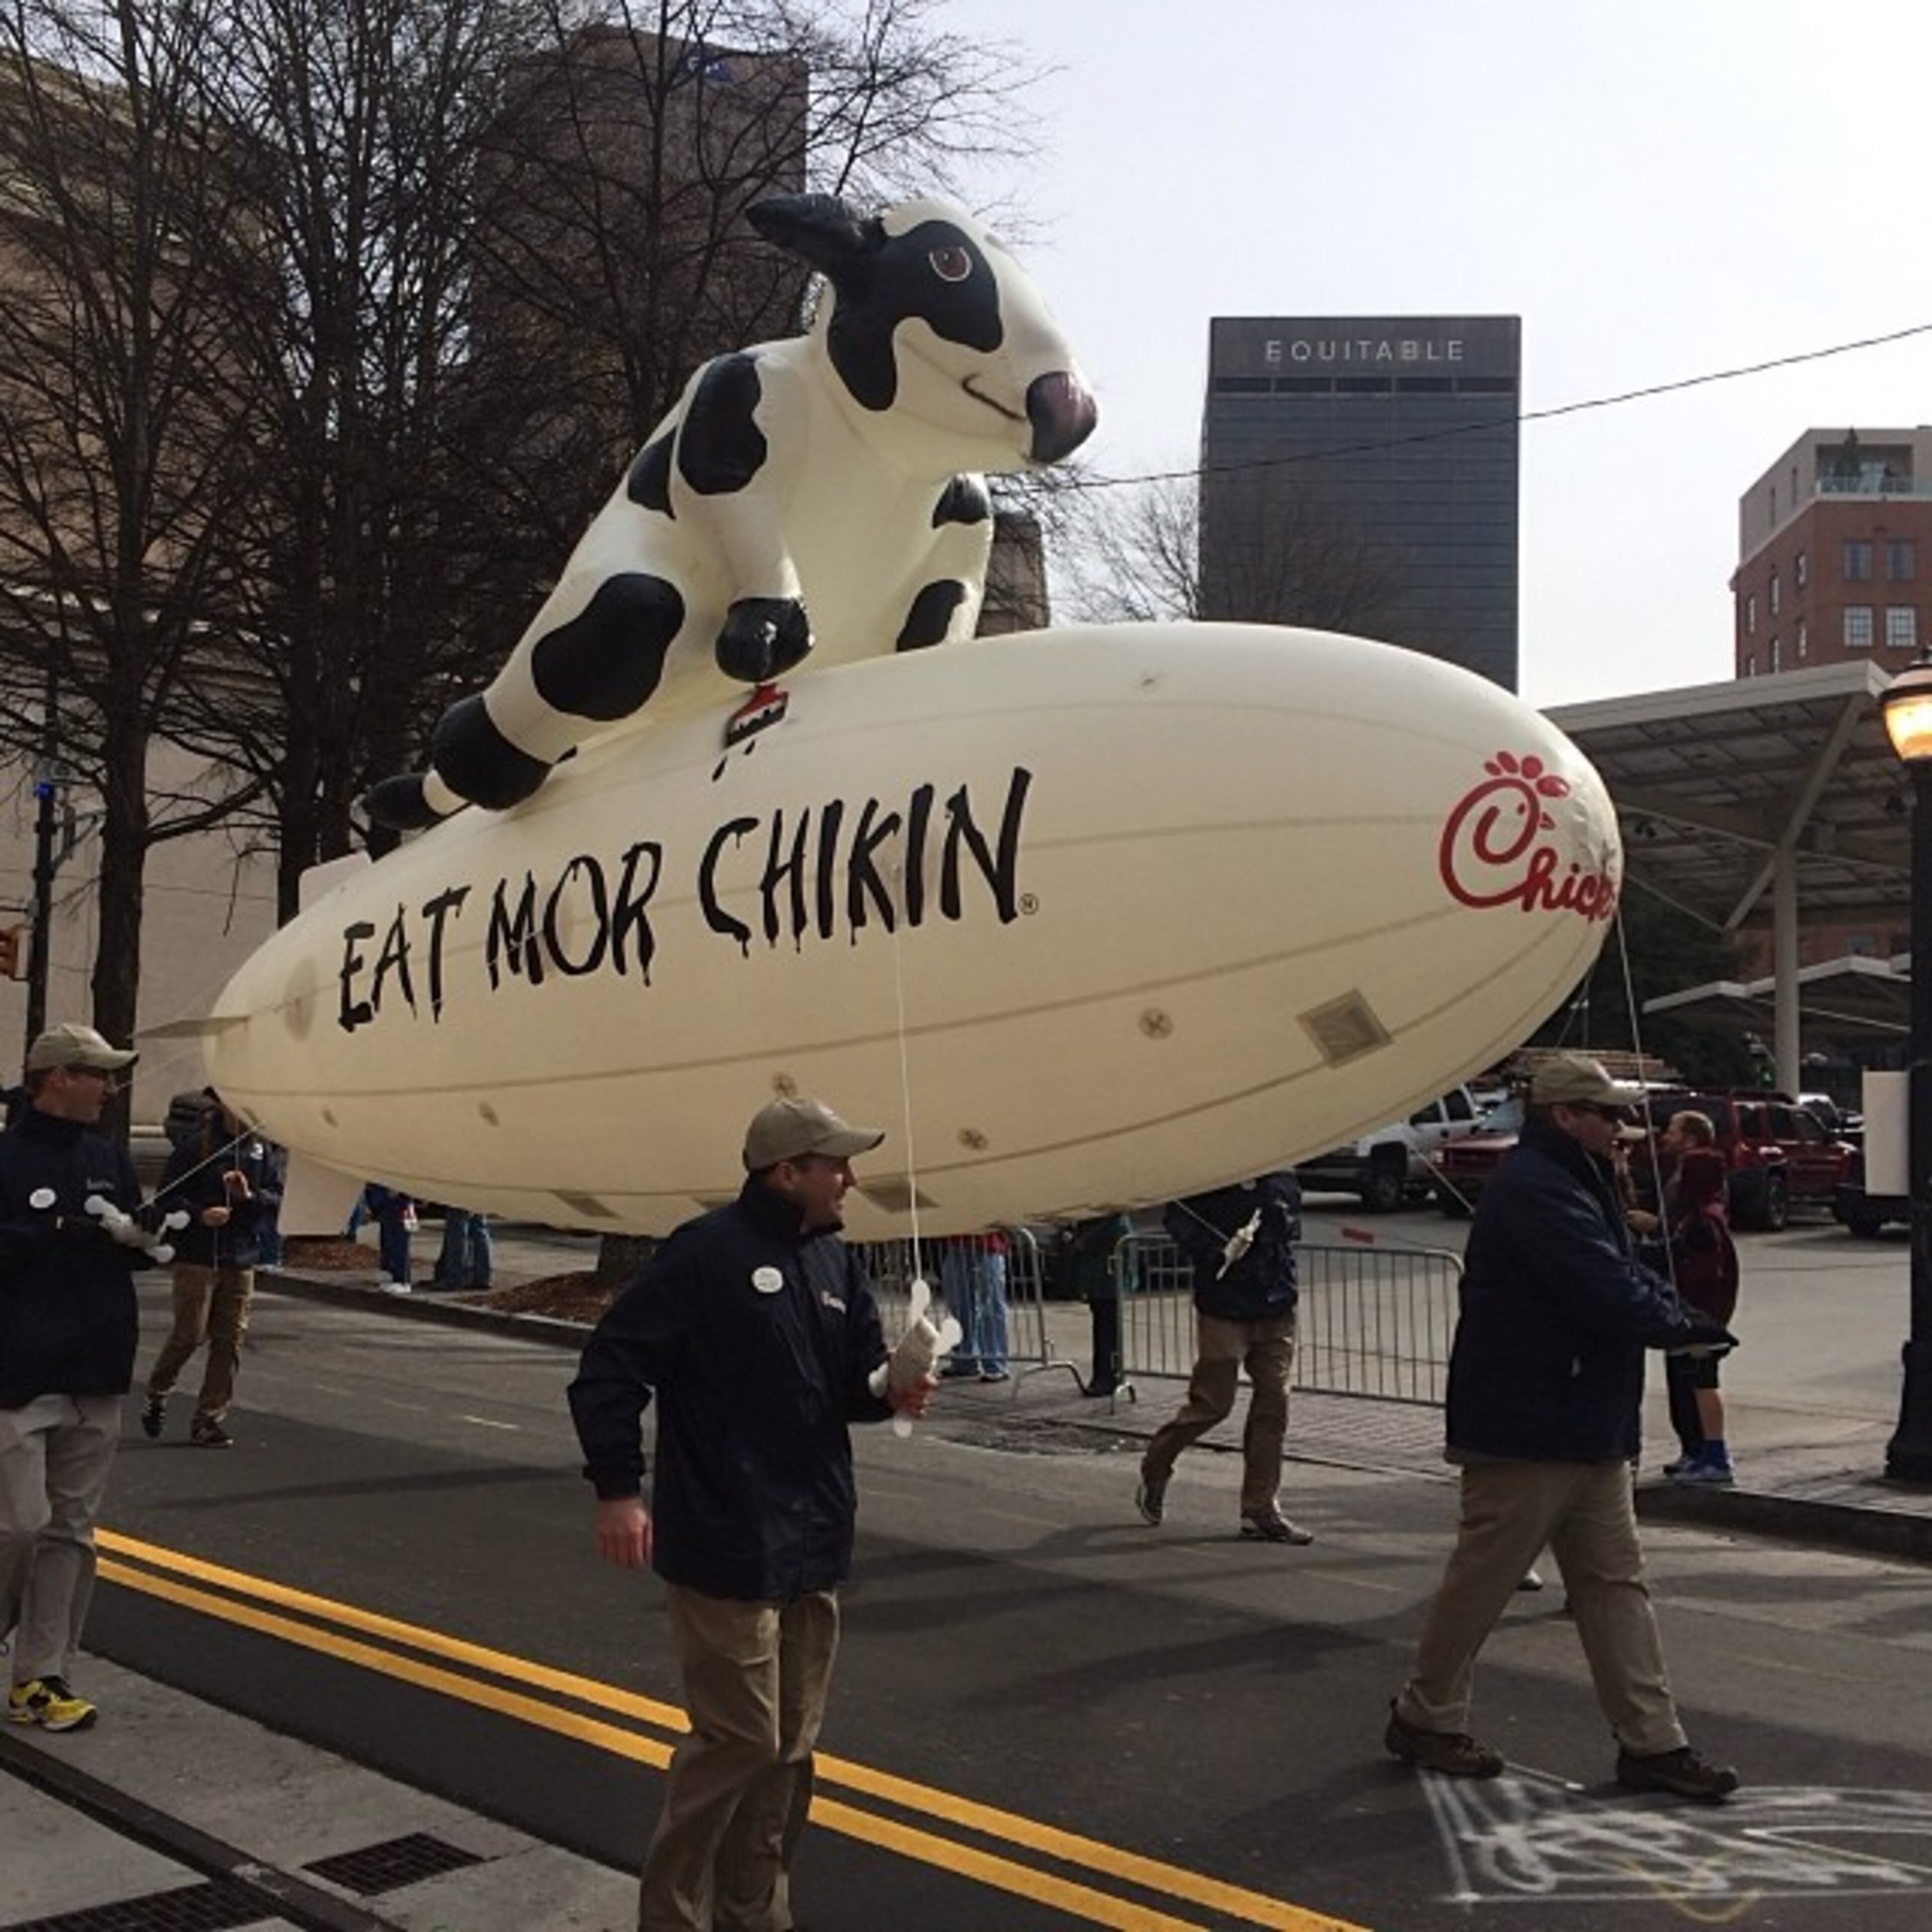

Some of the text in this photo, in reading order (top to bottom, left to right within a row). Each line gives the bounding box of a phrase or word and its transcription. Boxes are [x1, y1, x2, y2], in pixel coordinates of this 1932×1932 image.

[1266, 340, 1464, 361] EQUITABLE
[338, 766, 1032, 1033] EAT MOR CHIKIN
